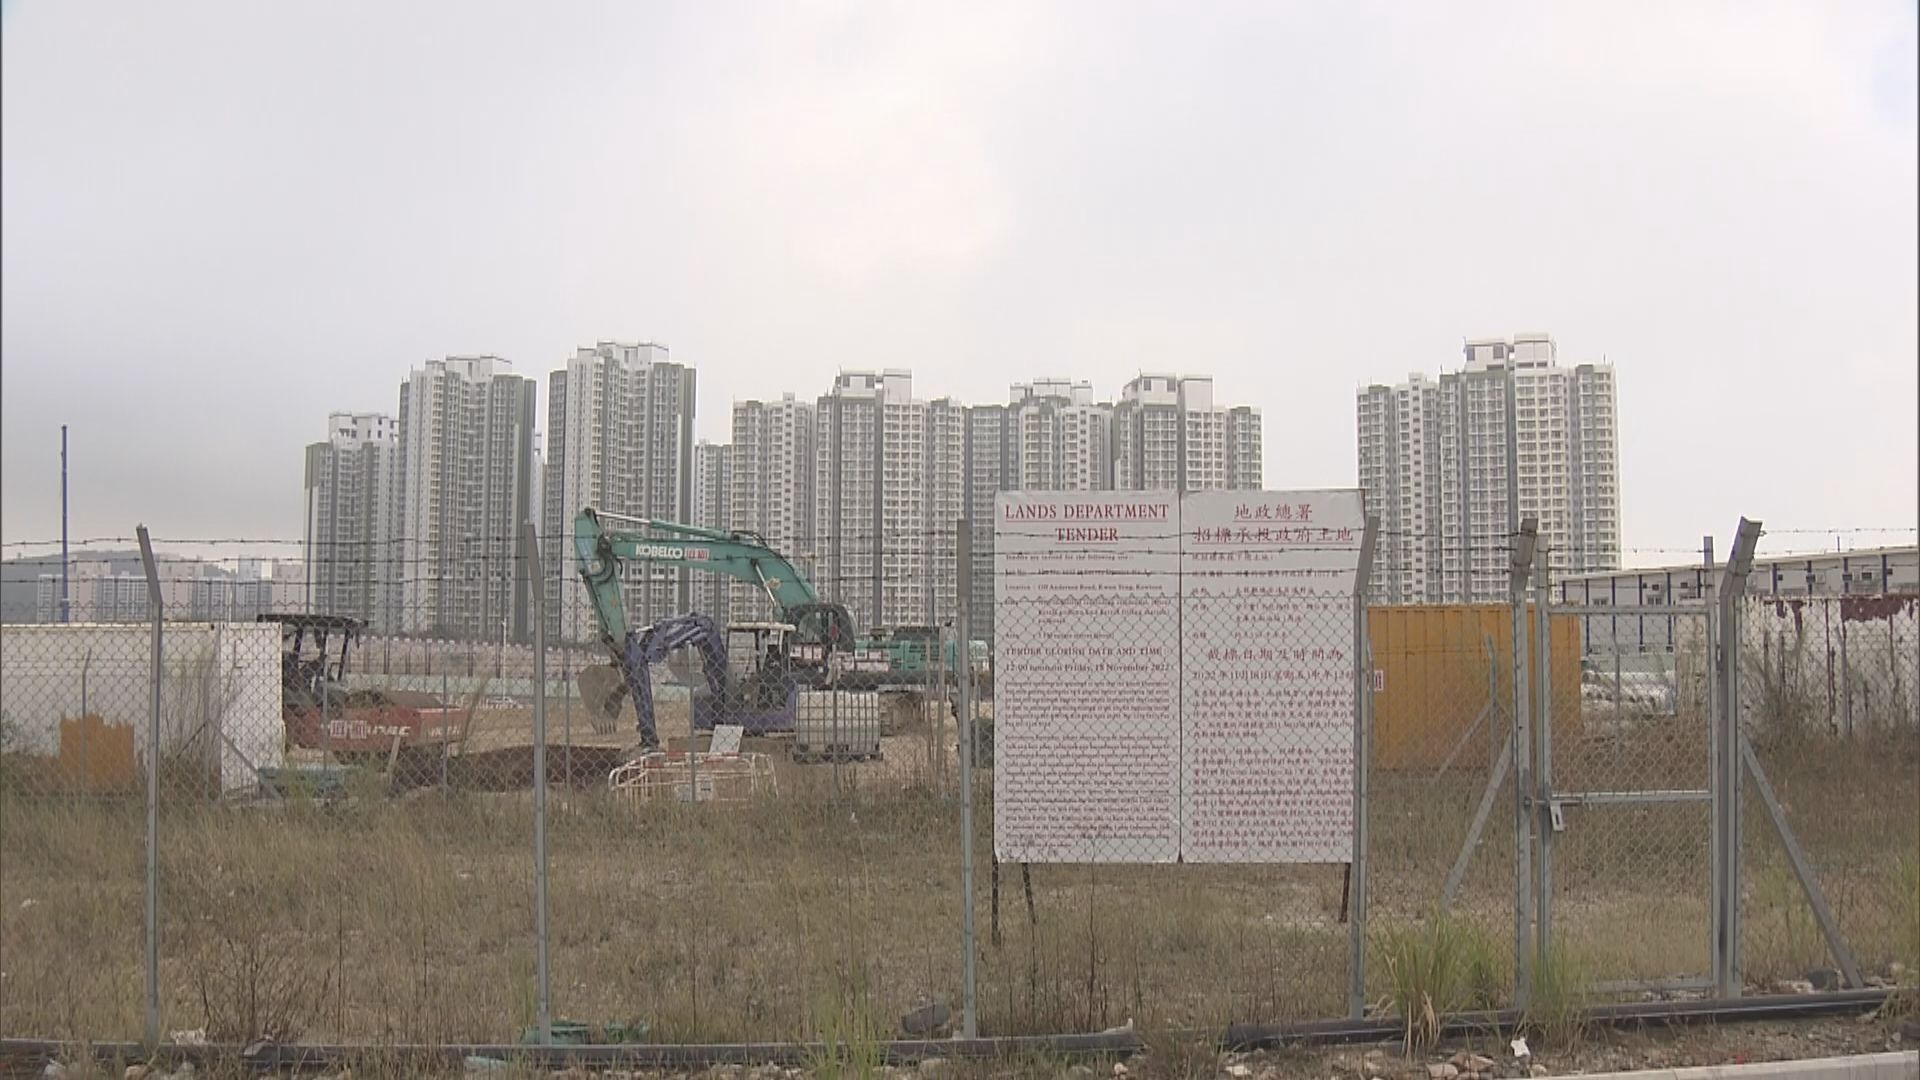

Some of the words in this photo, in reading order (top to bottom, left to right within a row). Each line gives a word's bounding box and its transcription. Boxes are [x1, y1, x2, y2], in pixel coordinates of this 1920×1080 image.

[1005, 504, 1057, 519] LANDS
[1063, 504, 1169, 519] DEPARTMENT
[1234, 503, 1313, 520] 地政總署
[1055, 528, 1119, 541] TENDER
[1193, 527, 1354, 542] 招標承投政府土地
[635, 544, 683, 559] KOBELCO
[1006, 648, 1041, 656] TENDER
[1045, 648, 1085, 656] CLOSING
[1088, 648, 1113, 656] DATE
[1116, 648, 1137, 656] AND
[1106, 663, 1149, 672] November
